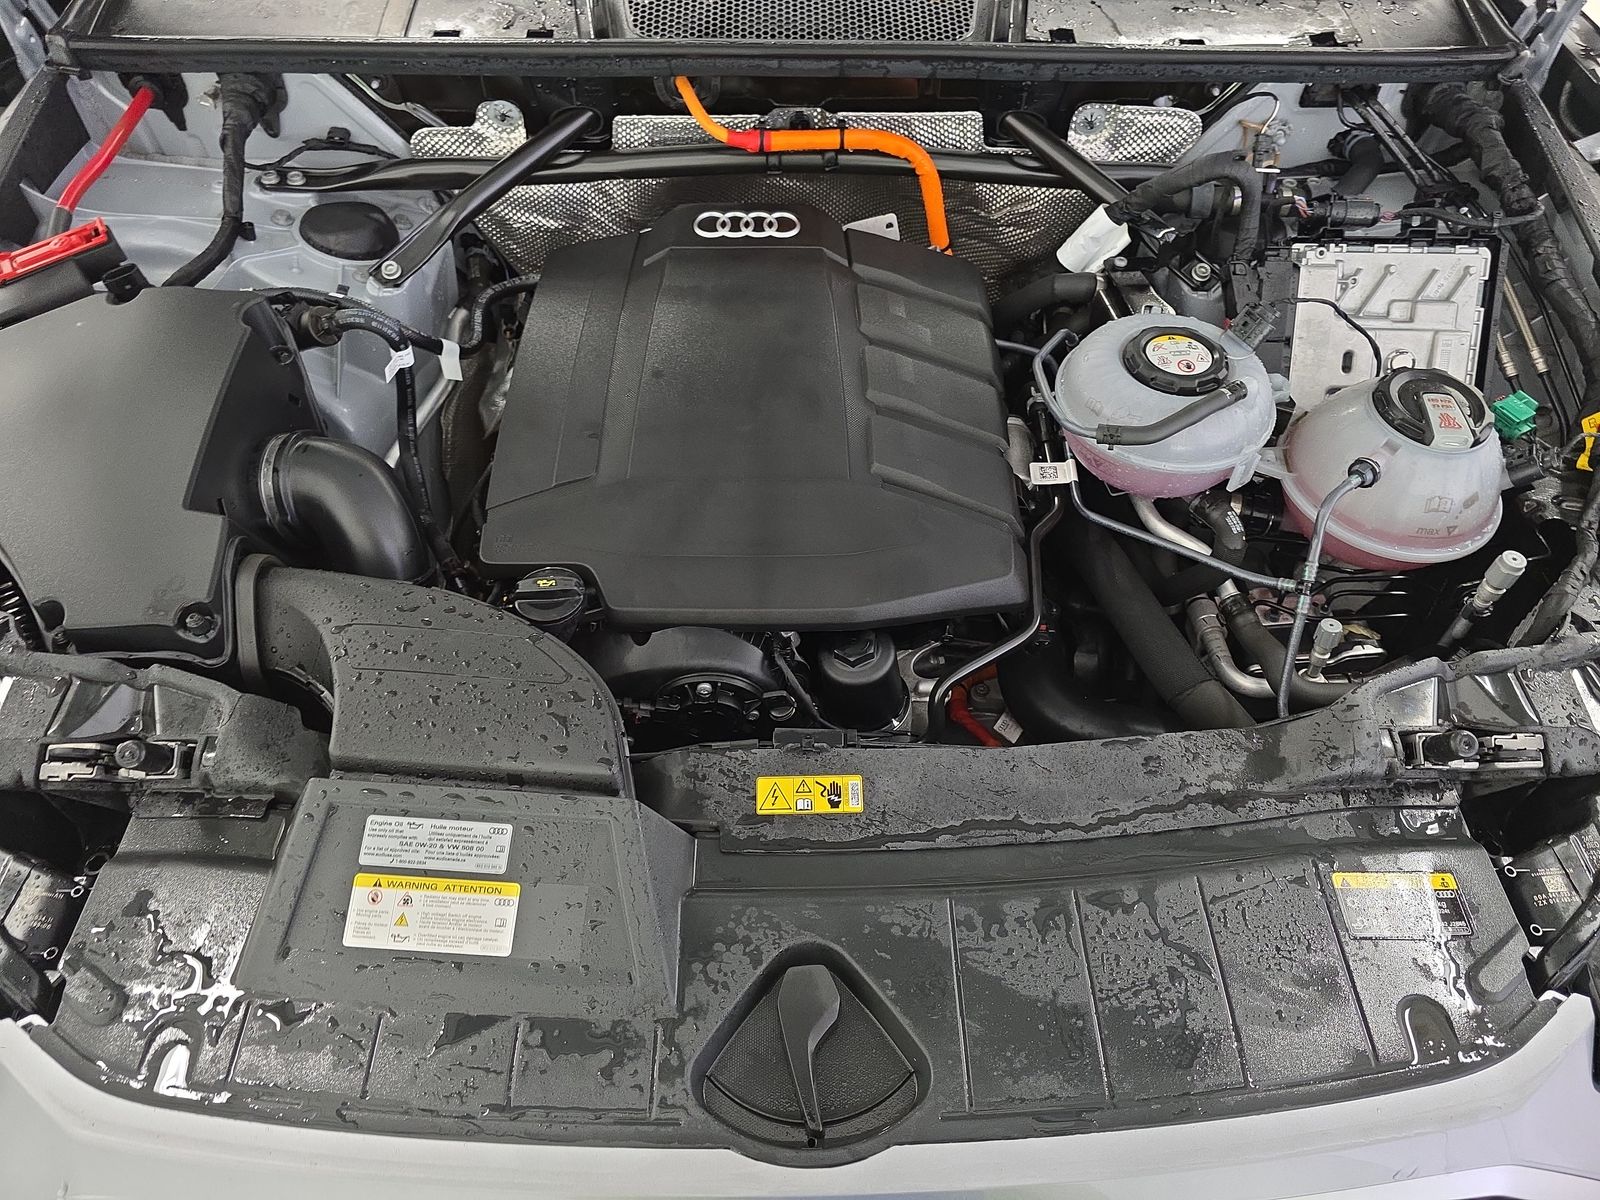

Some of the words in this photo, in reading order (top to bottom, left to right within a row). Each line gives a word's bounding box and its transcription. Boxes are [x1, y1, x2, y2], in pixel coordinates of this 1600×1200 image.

[1416, 527, 1440, 535] max
[387, 880, 438, 891] WARNING
[443, 884, 502, 895] ATTENTION
